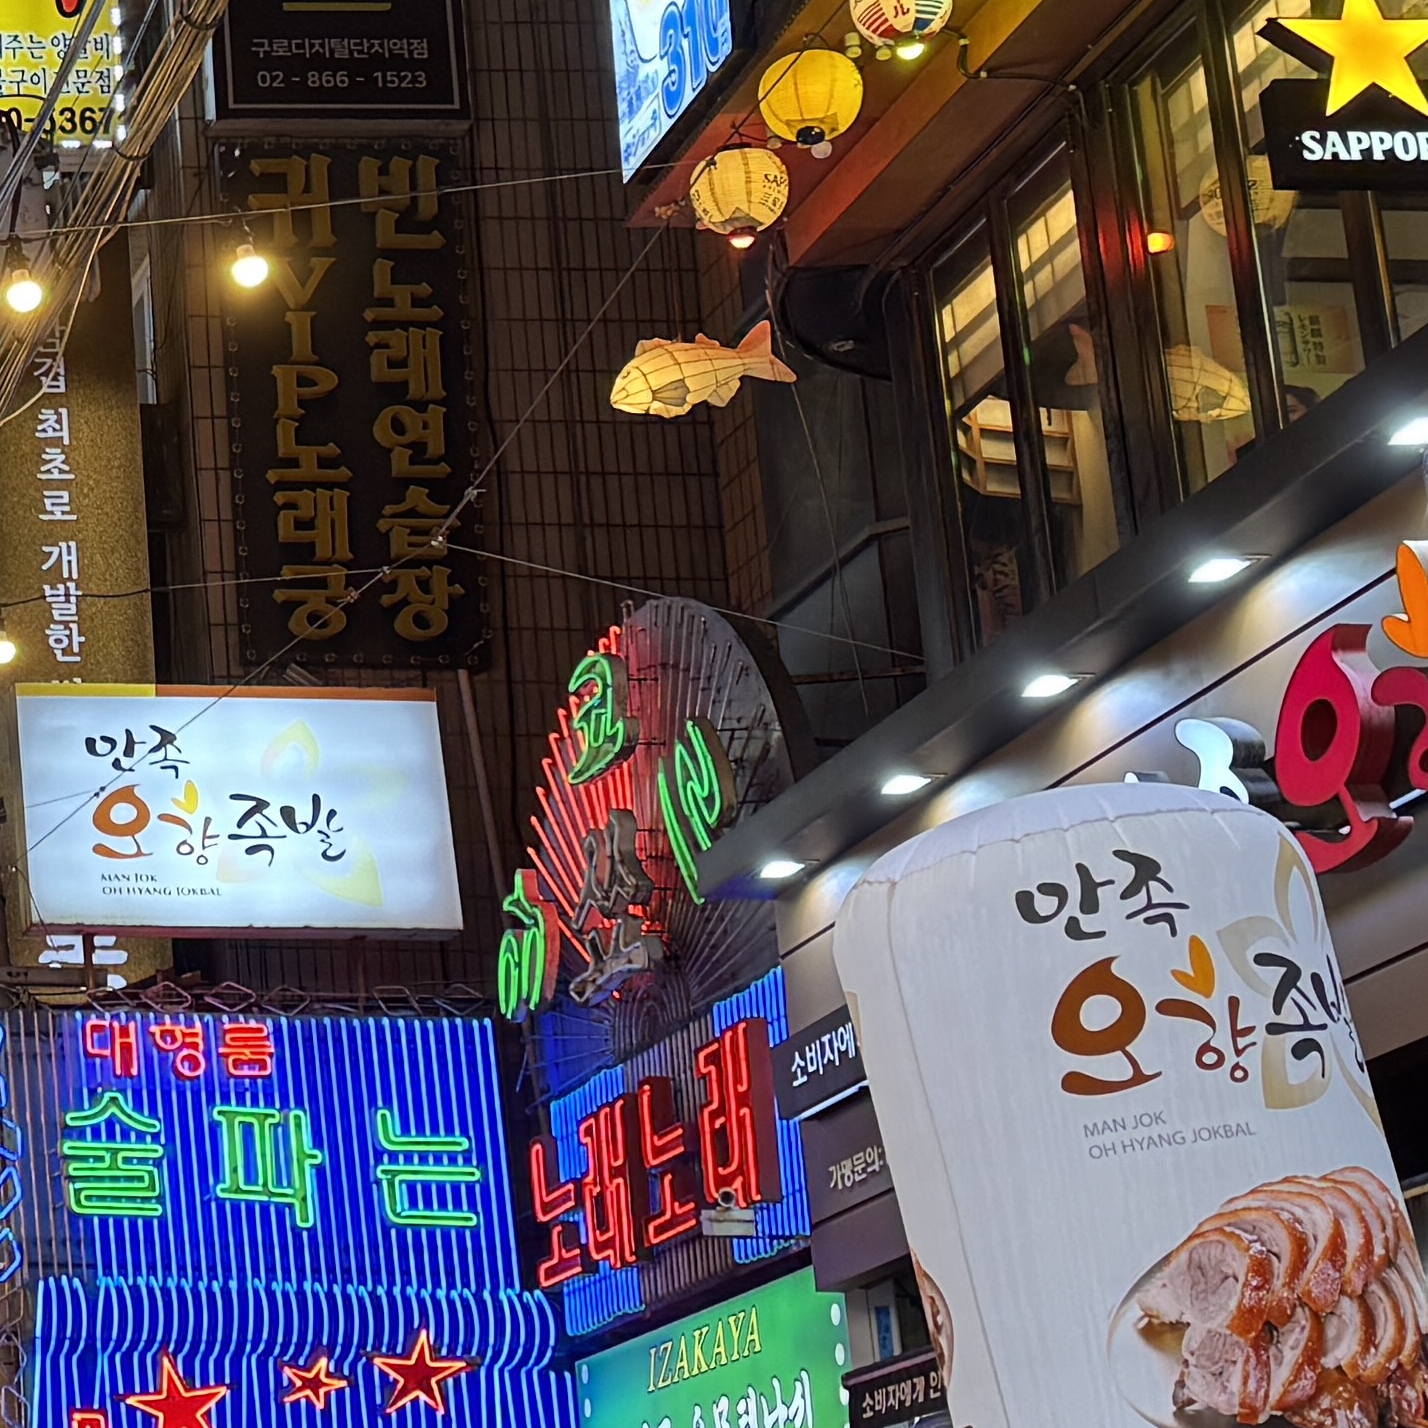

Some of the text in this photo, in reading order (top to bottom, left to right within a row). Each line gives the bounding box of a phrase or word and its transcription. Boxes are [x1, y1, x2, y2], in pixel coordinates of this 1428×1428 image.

[251, 36, 430, 62] 구로디지털단지역점
[36, 407, 78, 523] 최초로
[40, 541, 83, 664] 개발한
[85, 724, 191, 779] 만족
[1015, 849, 1189, 940] 만족
[84, 1018, 275, 1078] 대형룸
[790, 1022, 861, 1088] 소비자에
[1083, 1108, 1168, 1139] MAN JOK
[1088, 1120, 1257, 1160] OH HYANG JOKBAL
[646, 1306, 764, 1394] IZAKAYA
